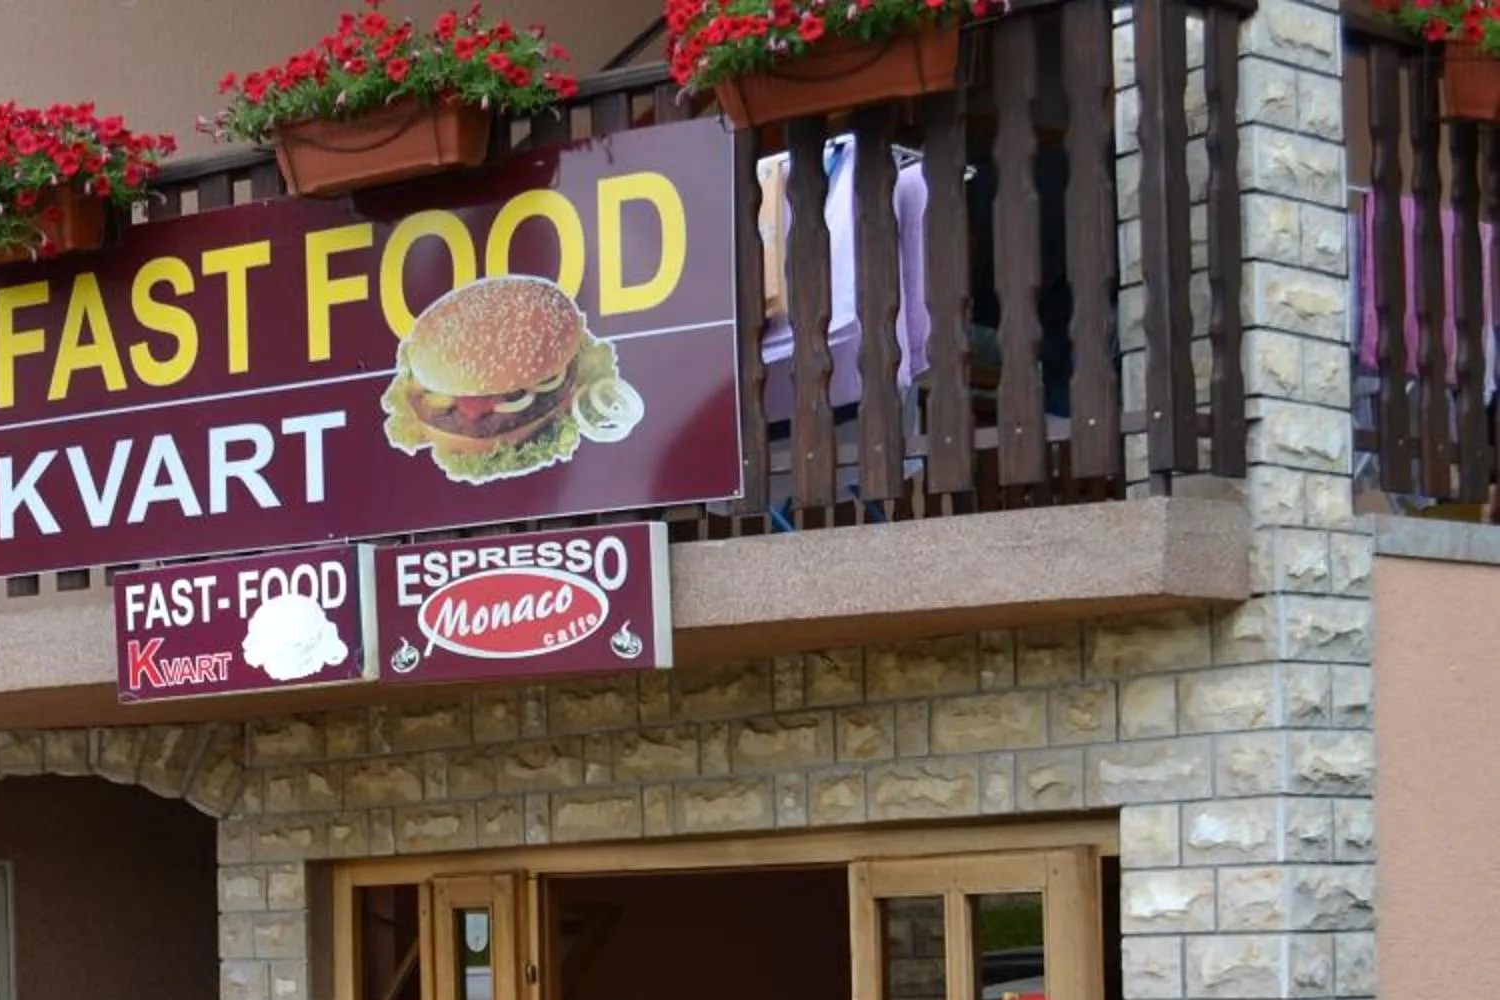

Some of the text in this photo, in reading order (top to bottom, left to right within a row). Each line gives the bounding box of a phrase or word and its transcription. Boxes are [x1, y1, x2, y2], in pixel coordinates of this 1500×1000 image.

[305, 171, 687, 362] FOOD
[396, 536, 628, 606] ESPRESSO
[423, 583, 574, 657] Monaco
[127, 637, 232, 691] KVART
